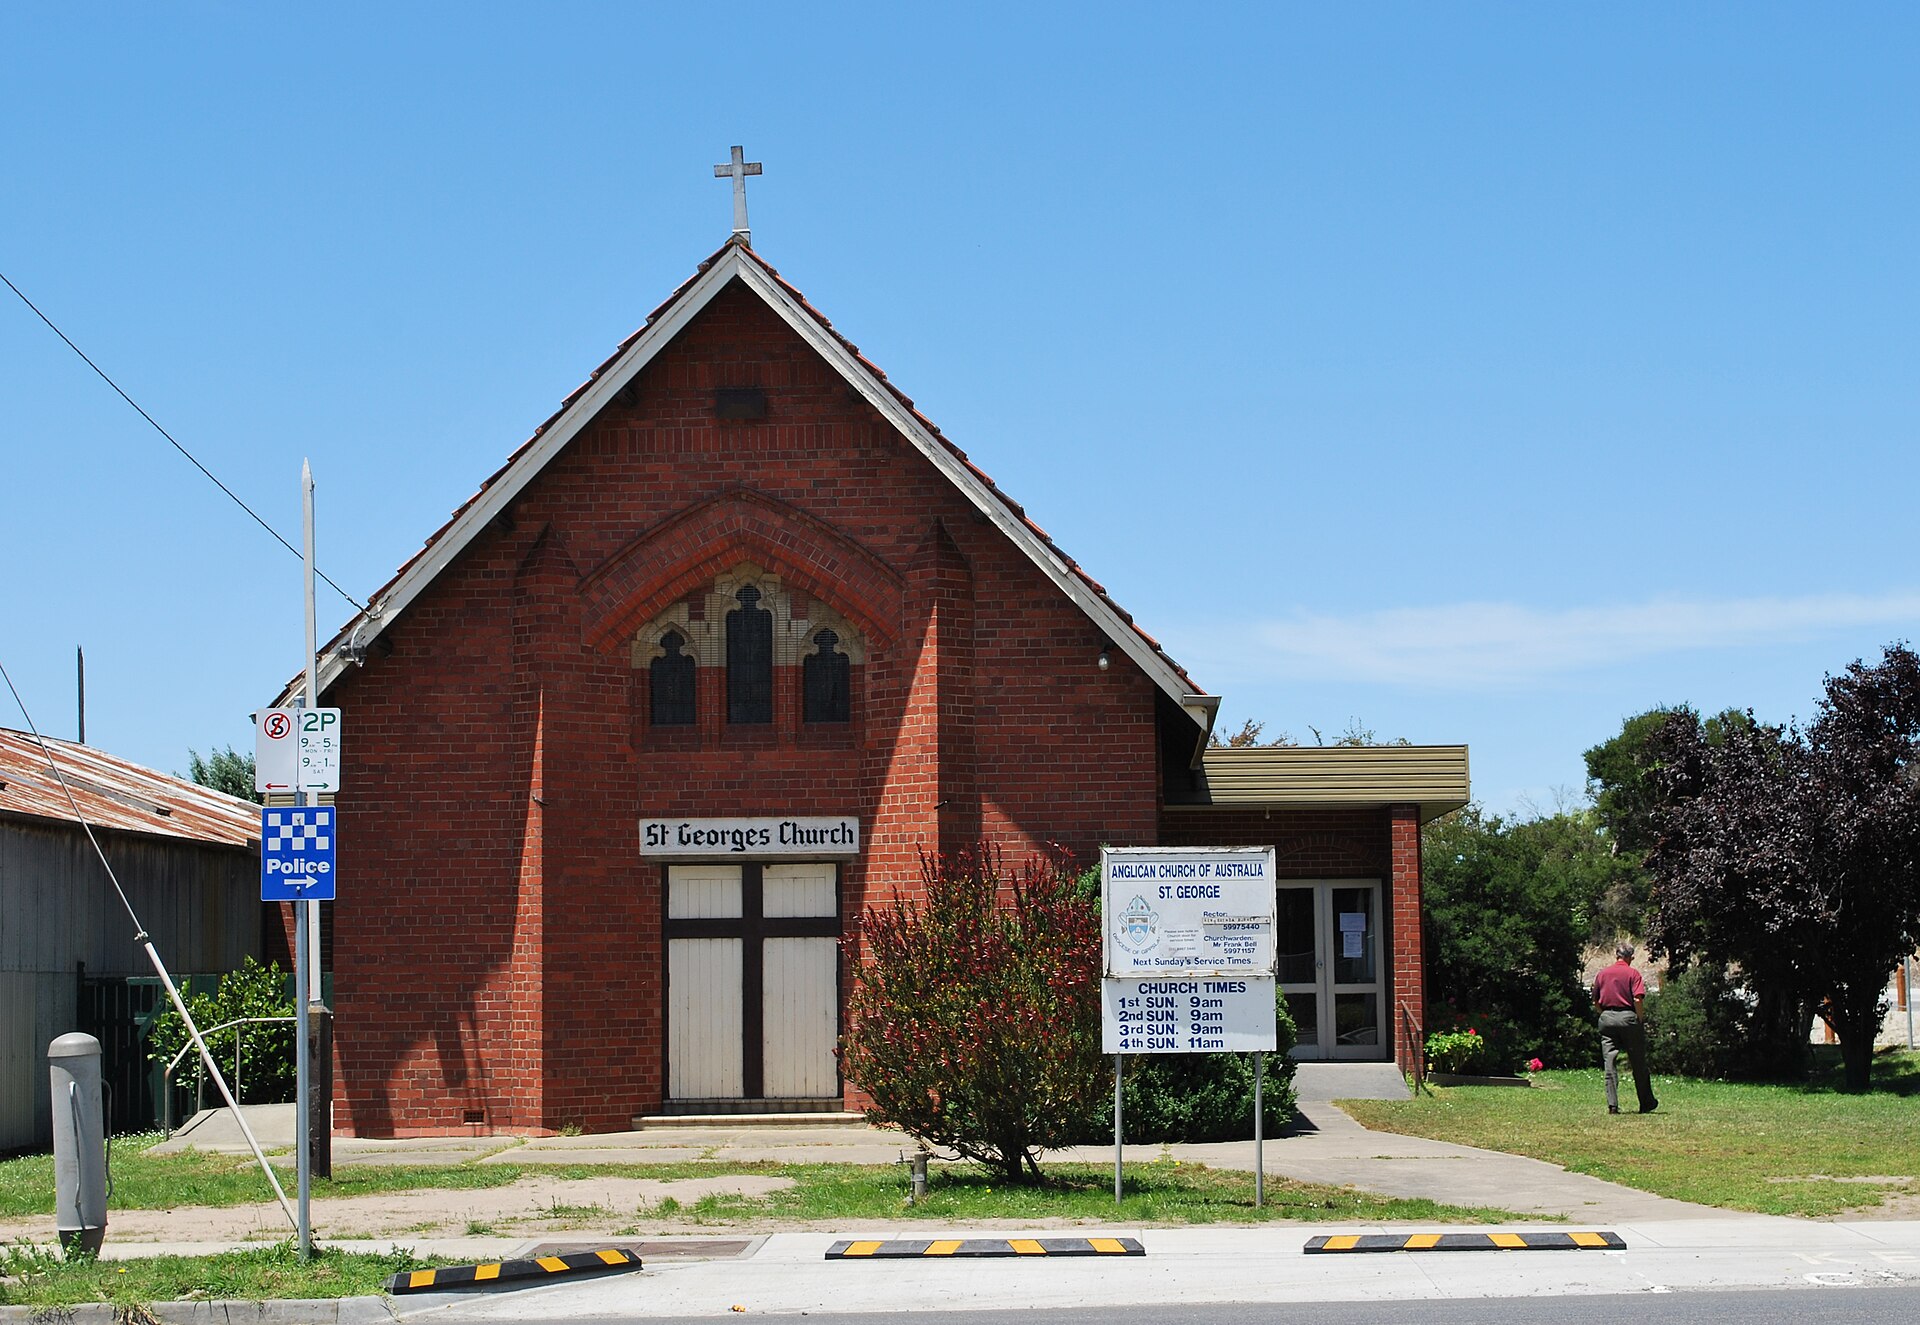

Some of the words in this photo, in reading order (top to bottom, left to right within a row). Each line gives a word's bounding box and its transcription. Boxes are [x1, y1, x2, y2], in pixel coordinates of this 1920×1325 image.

[303, 712, 337, 732] 2P
[645, 823, 670, 846] St
[677, 822, 771, 852] Georges
[778, 821, 855, 845] Church
[266, 858, 331, 875] Police
[1111, 864, 1156, 879] ANGLICAN
[1158, 863, 1196, 878] CHURCH
[1199, 864, 1211, 878] OF
[1214, 863, 1264, 877] AUSTRALIA
[1158, 885, 1173, 899] ST.
[1176, 885, 1221, 899] GEORGE
[1133, 958, 1152, 966] Next
[1154, 956, 1192, 967] Sunday's
[1194, 956, 1225, 966] Service
[1138, 982, 1198, 995] CHURCH
[1203, 981, 1247, 994] TIMES
[1118, 997, 1140, 1009] 1st
[1145, 996, 1179, 1008] SUN.
[1189, 996, 1223, 1008] 9am
[1118, 1010, 1144, 1022] 2nd
[1146, 1010, 1179, 1022] SUN.
[1190, 1009, 1223, 1021] 9am
[1119, 1024, 1144, 1036] 3rd
[1146, 1023, 1179, 1035] SUN.
[1190, 1023, 1223, 1035] 9am
[1119, 1037, 1144, 1050] 4th
[1146, 1037, 1179, 1049] SUN.
[1187, 1037, 1224, 1049] 11am
